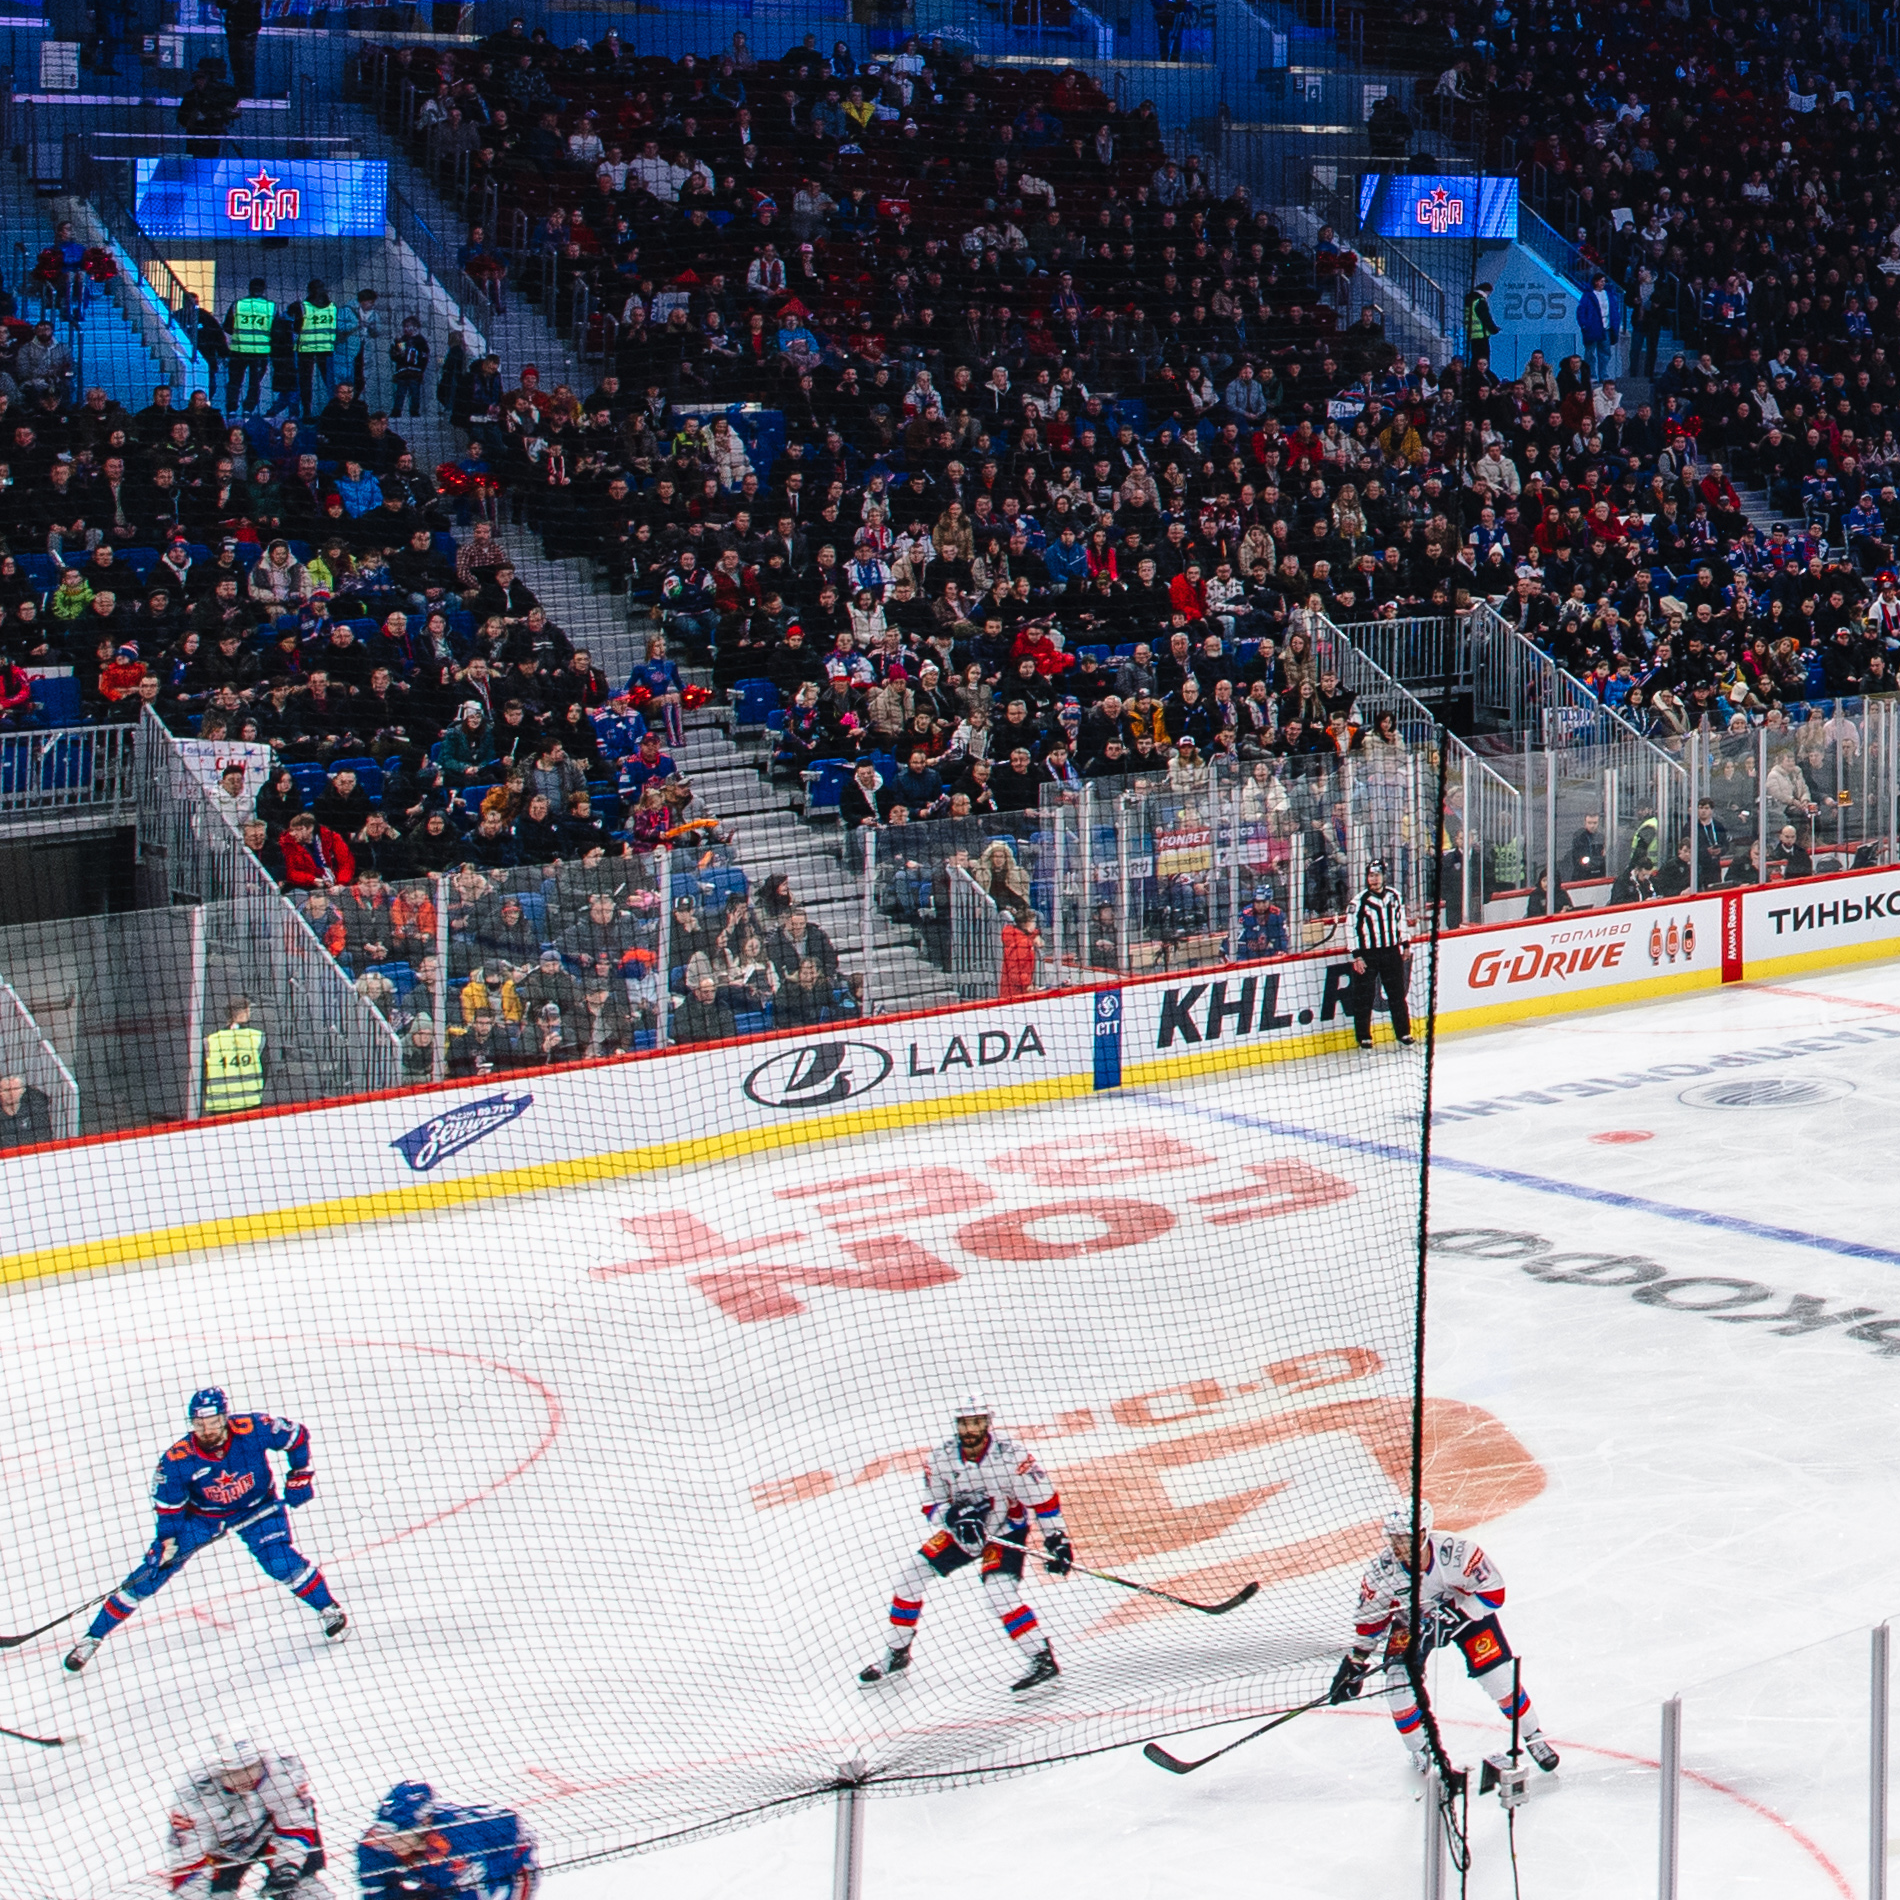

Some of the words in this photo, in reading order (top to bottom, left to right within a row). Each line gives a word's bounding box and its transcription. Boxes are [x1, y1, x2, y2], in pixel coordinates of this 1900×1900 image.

[1550, 922, 1632, 945] ТОПЛИВО
[1156, 963, 1402, 1048] KHL.R
[909, 1025, 1046, 1078] LADA
